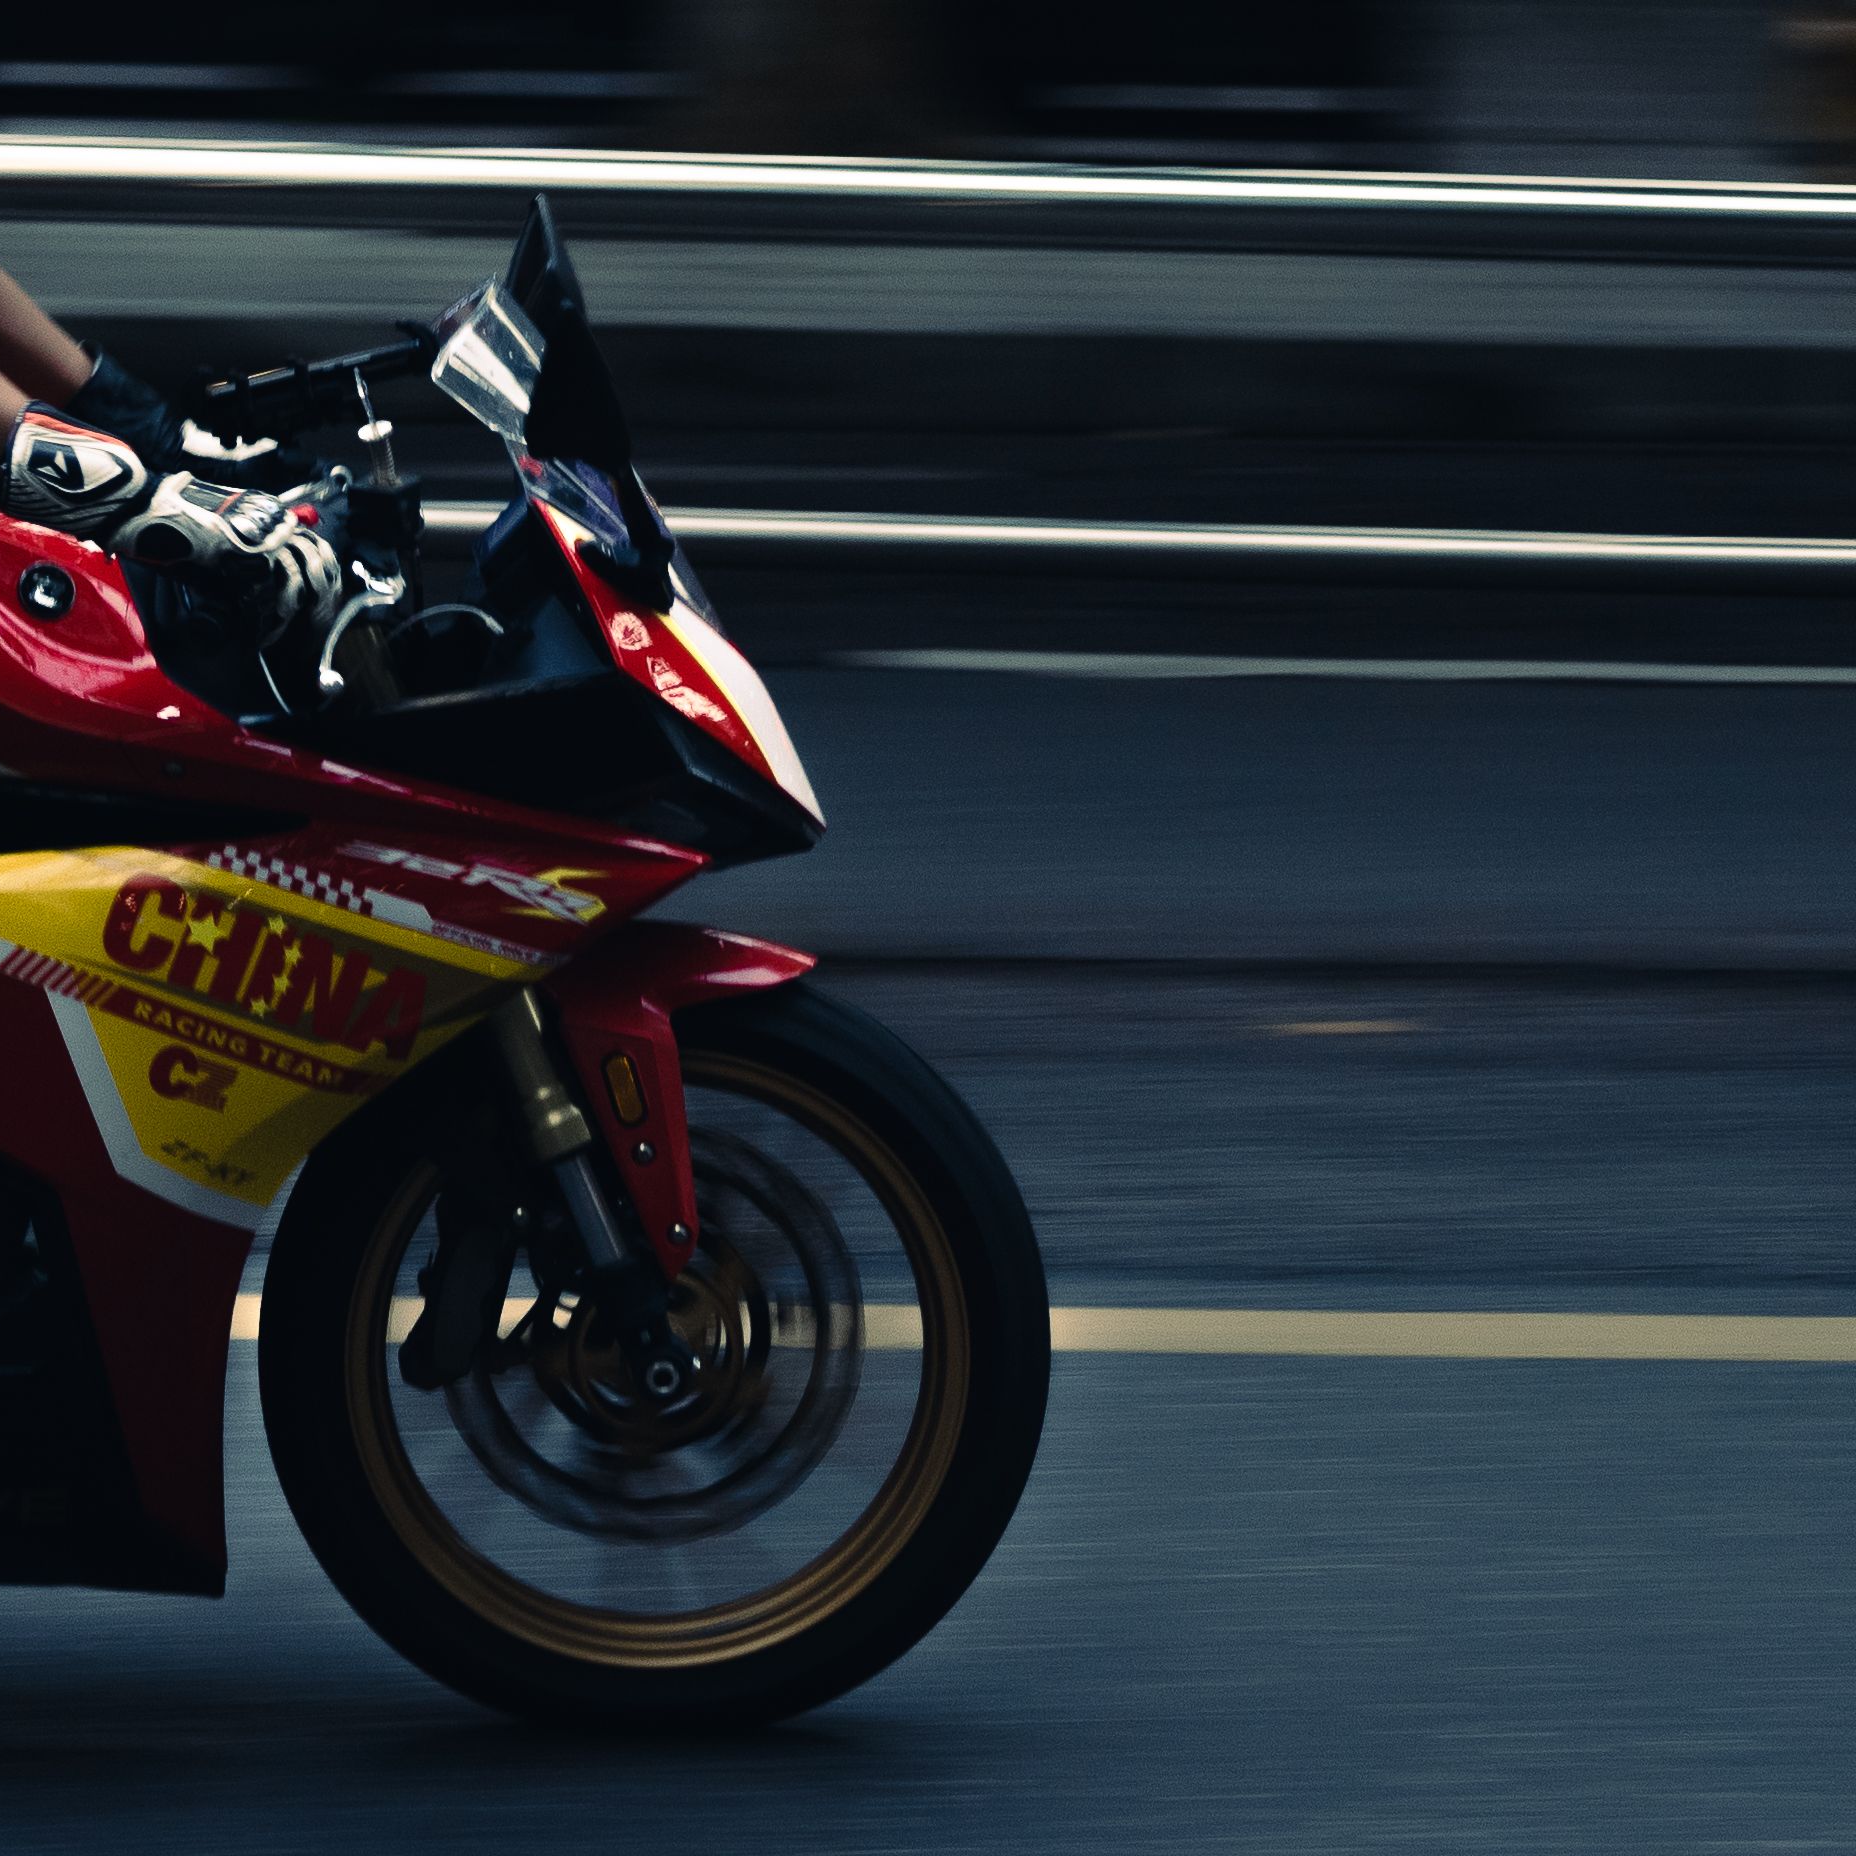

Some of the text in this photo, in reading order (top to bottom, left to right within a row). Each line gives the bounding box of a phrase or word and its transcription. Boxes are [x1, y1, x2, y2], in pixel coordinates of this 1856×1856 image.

[103, 875, 427, 1061] CHINA
[133, 999, 341, 1085] RACING TEAM
